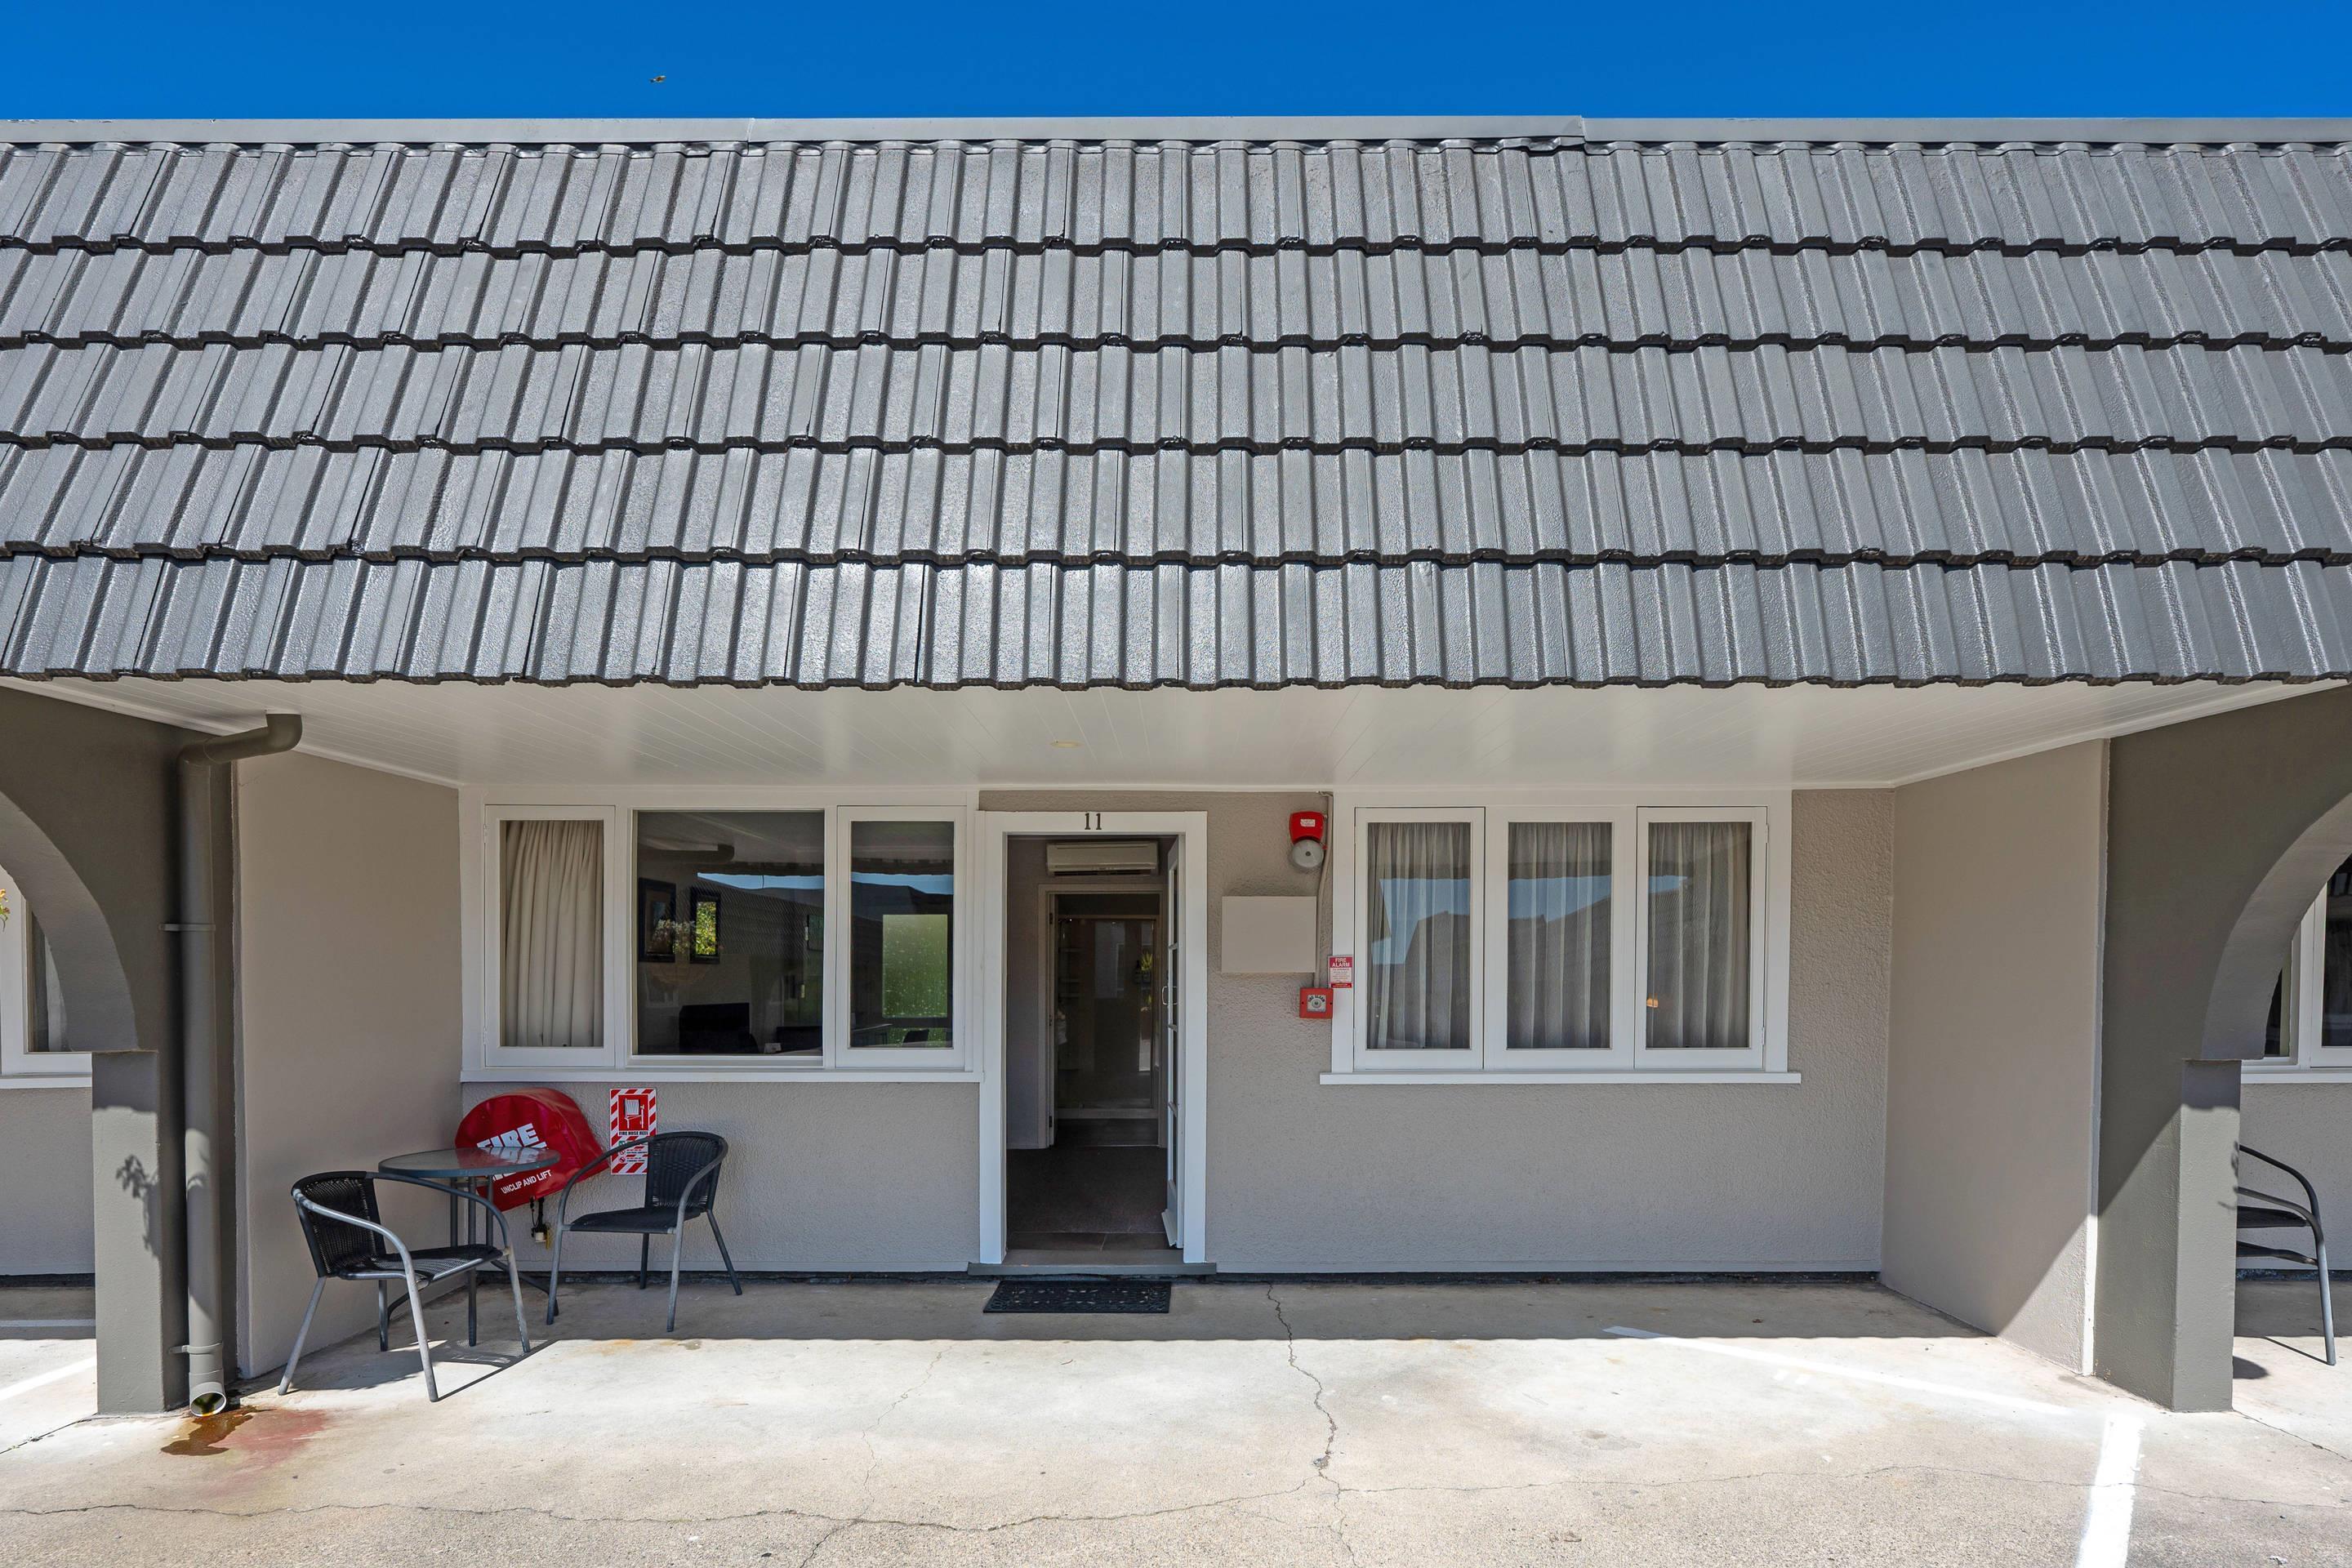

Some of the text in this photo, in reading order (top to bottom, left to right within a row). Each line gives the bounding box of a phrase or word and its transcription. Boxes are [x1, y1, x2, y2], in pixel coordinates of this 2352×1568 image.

[1085, 813, 1102, 830] 11
[501, 1181, 523, 1194] UNCLIP
[523, 1176, 537, 1187] AND
[537, 1169, 552, 1181] LIFT
